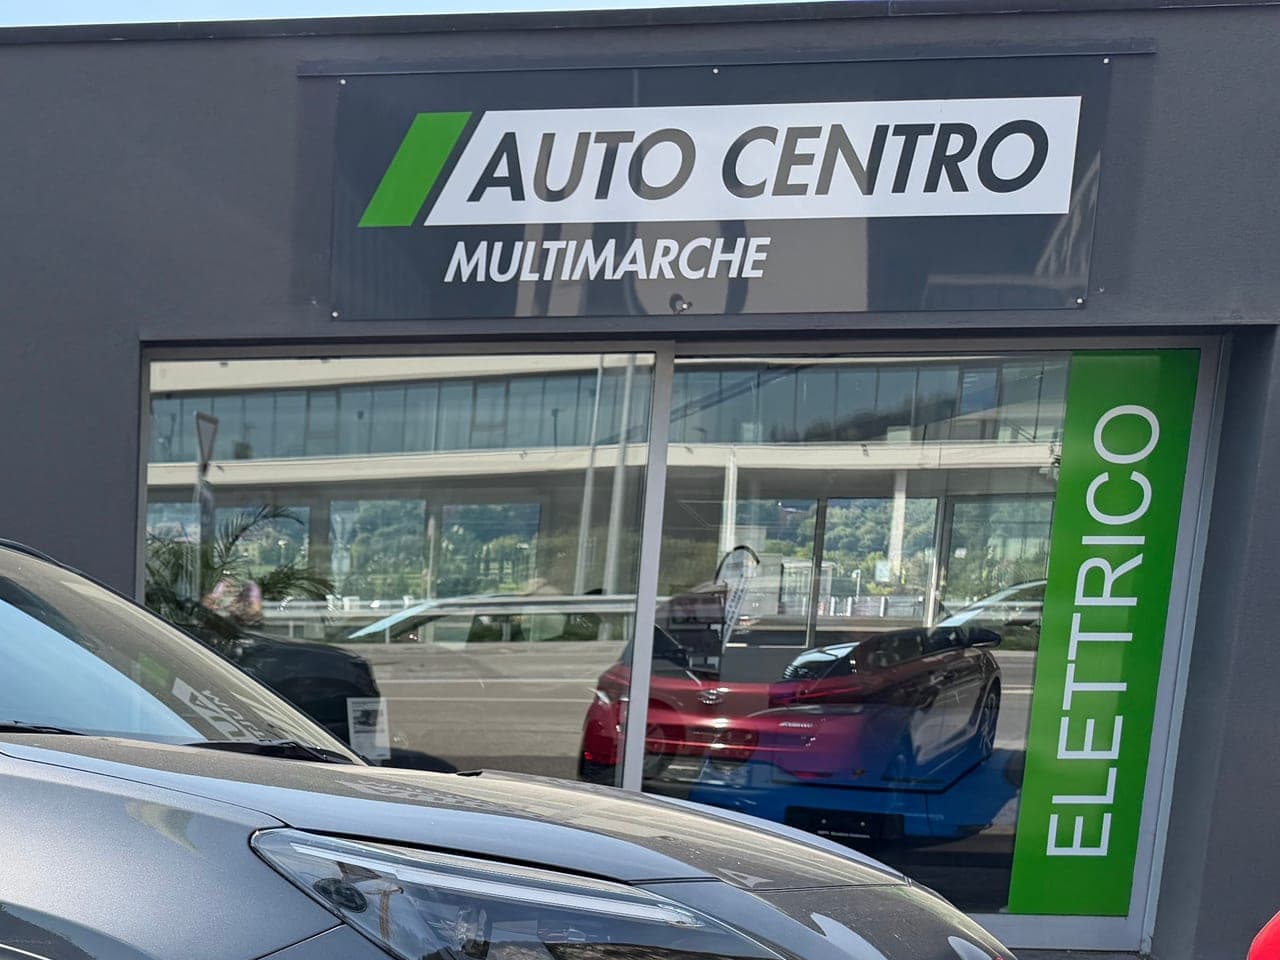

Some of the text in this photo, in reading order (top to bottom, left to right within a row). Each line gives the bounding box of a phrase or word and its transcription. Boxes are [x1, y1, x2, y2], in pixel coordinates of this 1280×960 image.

[466, 119, 1049, 203] AUTO CENTRO
[443, 237, 771, 283] MULTIMARCHE
[1046, 404, 1160, 856] ELETTRICO
